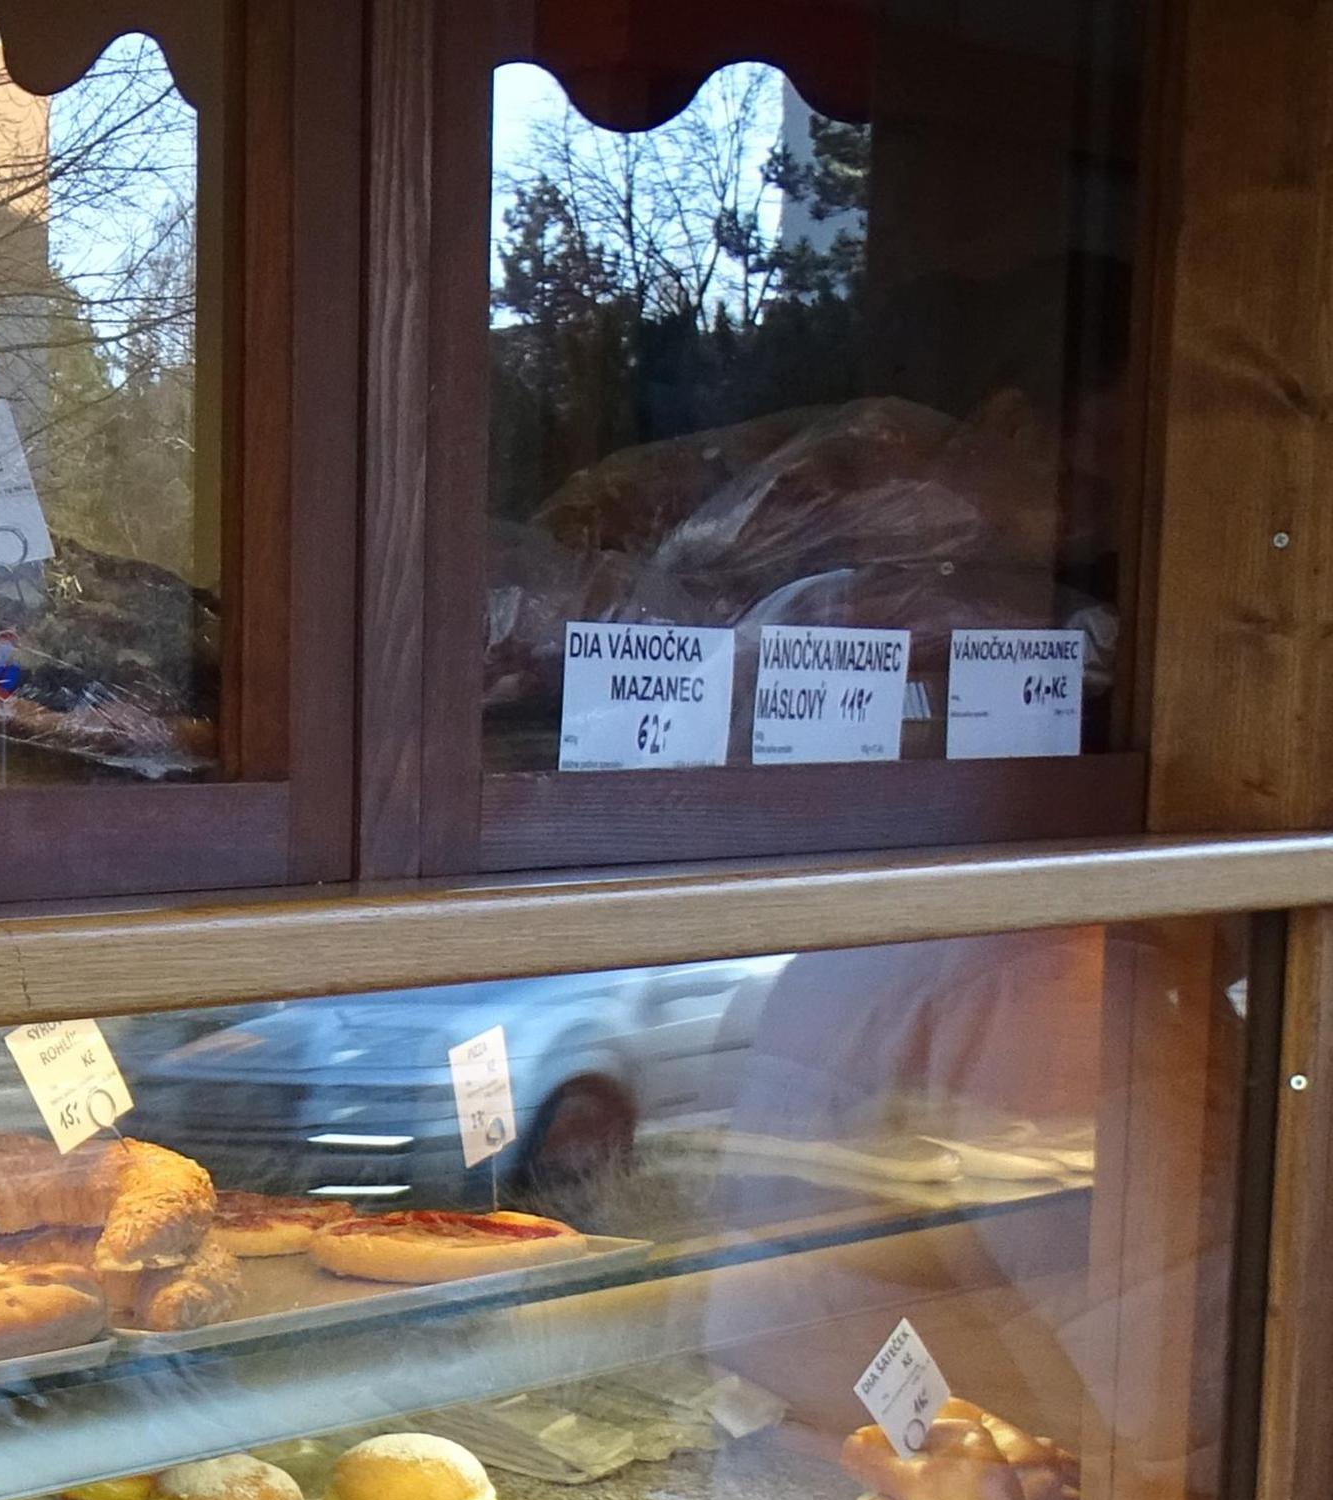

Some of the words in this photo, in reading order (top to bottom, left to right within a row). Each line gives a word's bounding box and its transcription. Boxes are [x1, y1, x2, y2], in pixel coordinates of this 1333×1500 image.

[569, 632, 602, 659] DIA
[608, 629, 702, 662] VÁNOČKA
[611, 675, 704, 702] MAZANEC
[756, 681, 826, 720] MÁSLOVÝ
